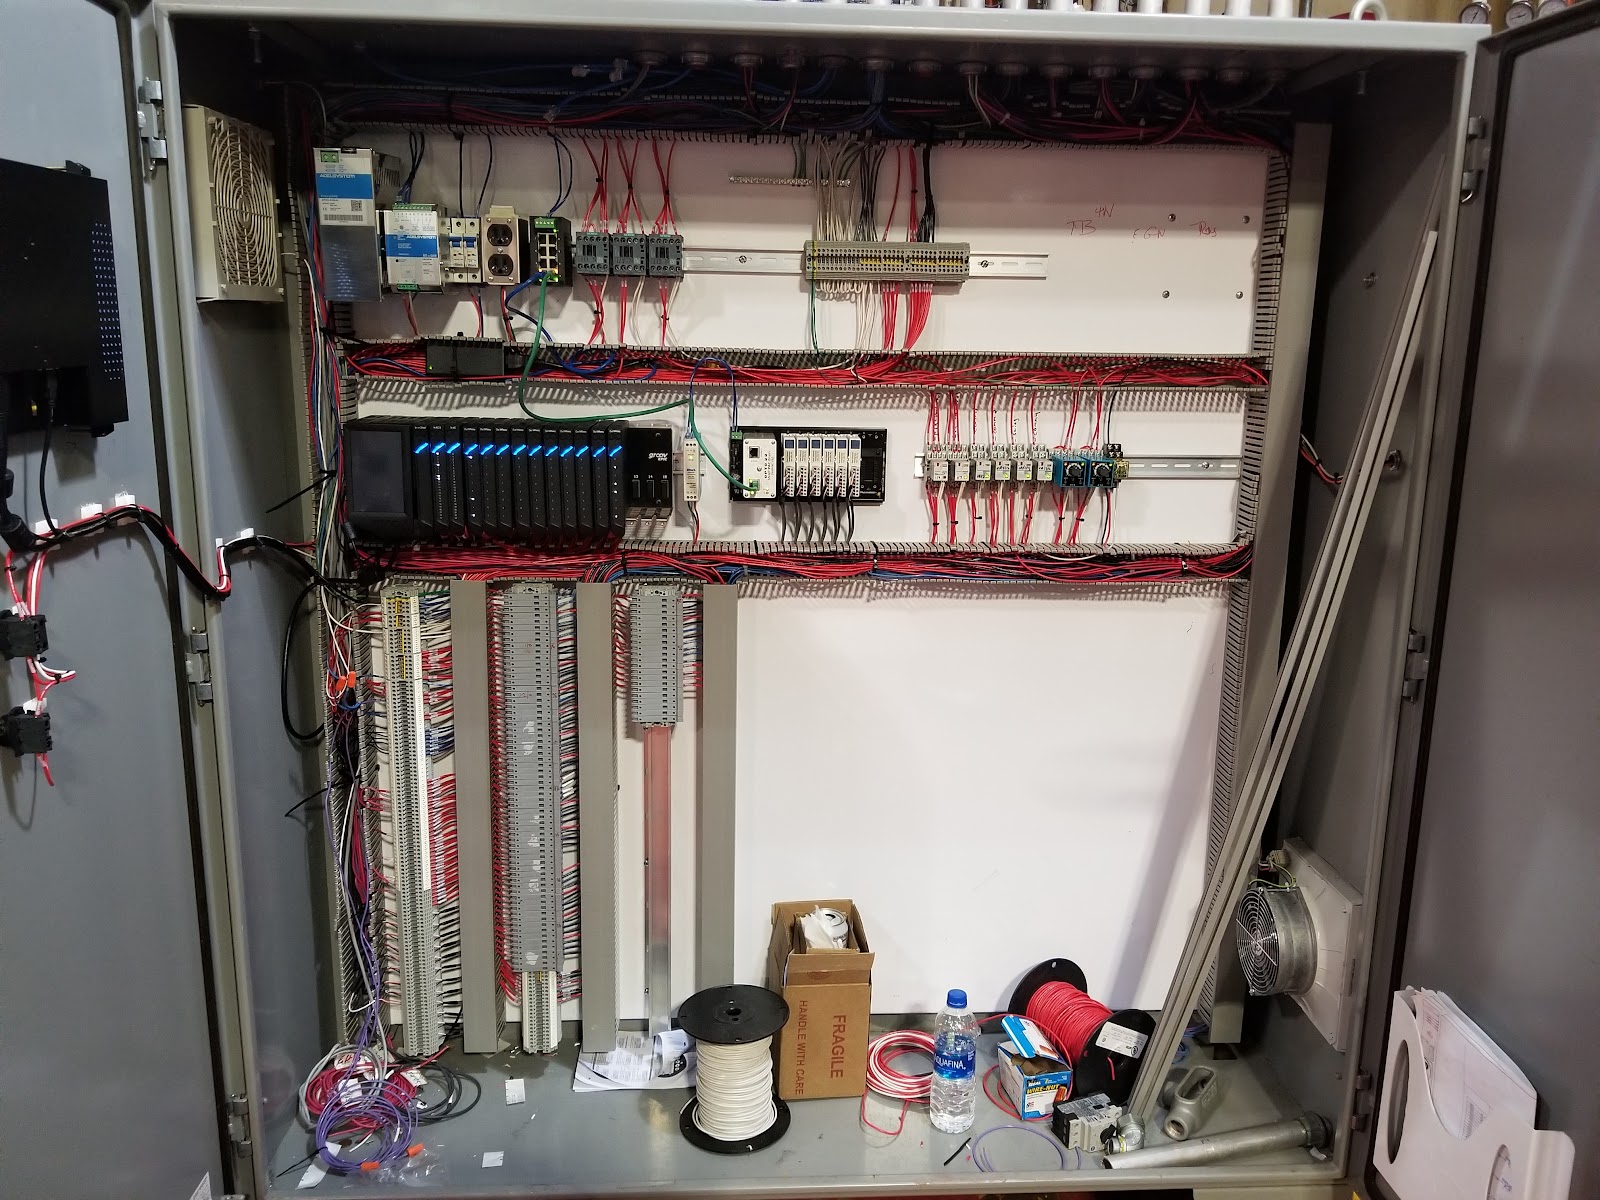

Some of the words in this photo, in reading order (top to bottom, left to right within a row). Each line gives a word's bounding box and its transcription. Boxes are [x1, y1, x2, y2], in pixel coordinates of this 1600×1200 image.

[1066, 219, 1097, 236] TB
[797, 1000, 808, 1040] HANDLE
[796, 1042, 807, 1066] WITH
[830, 1014, 847, 1079] FRAGILE
[795, 1068, 805, 1095] CARE
